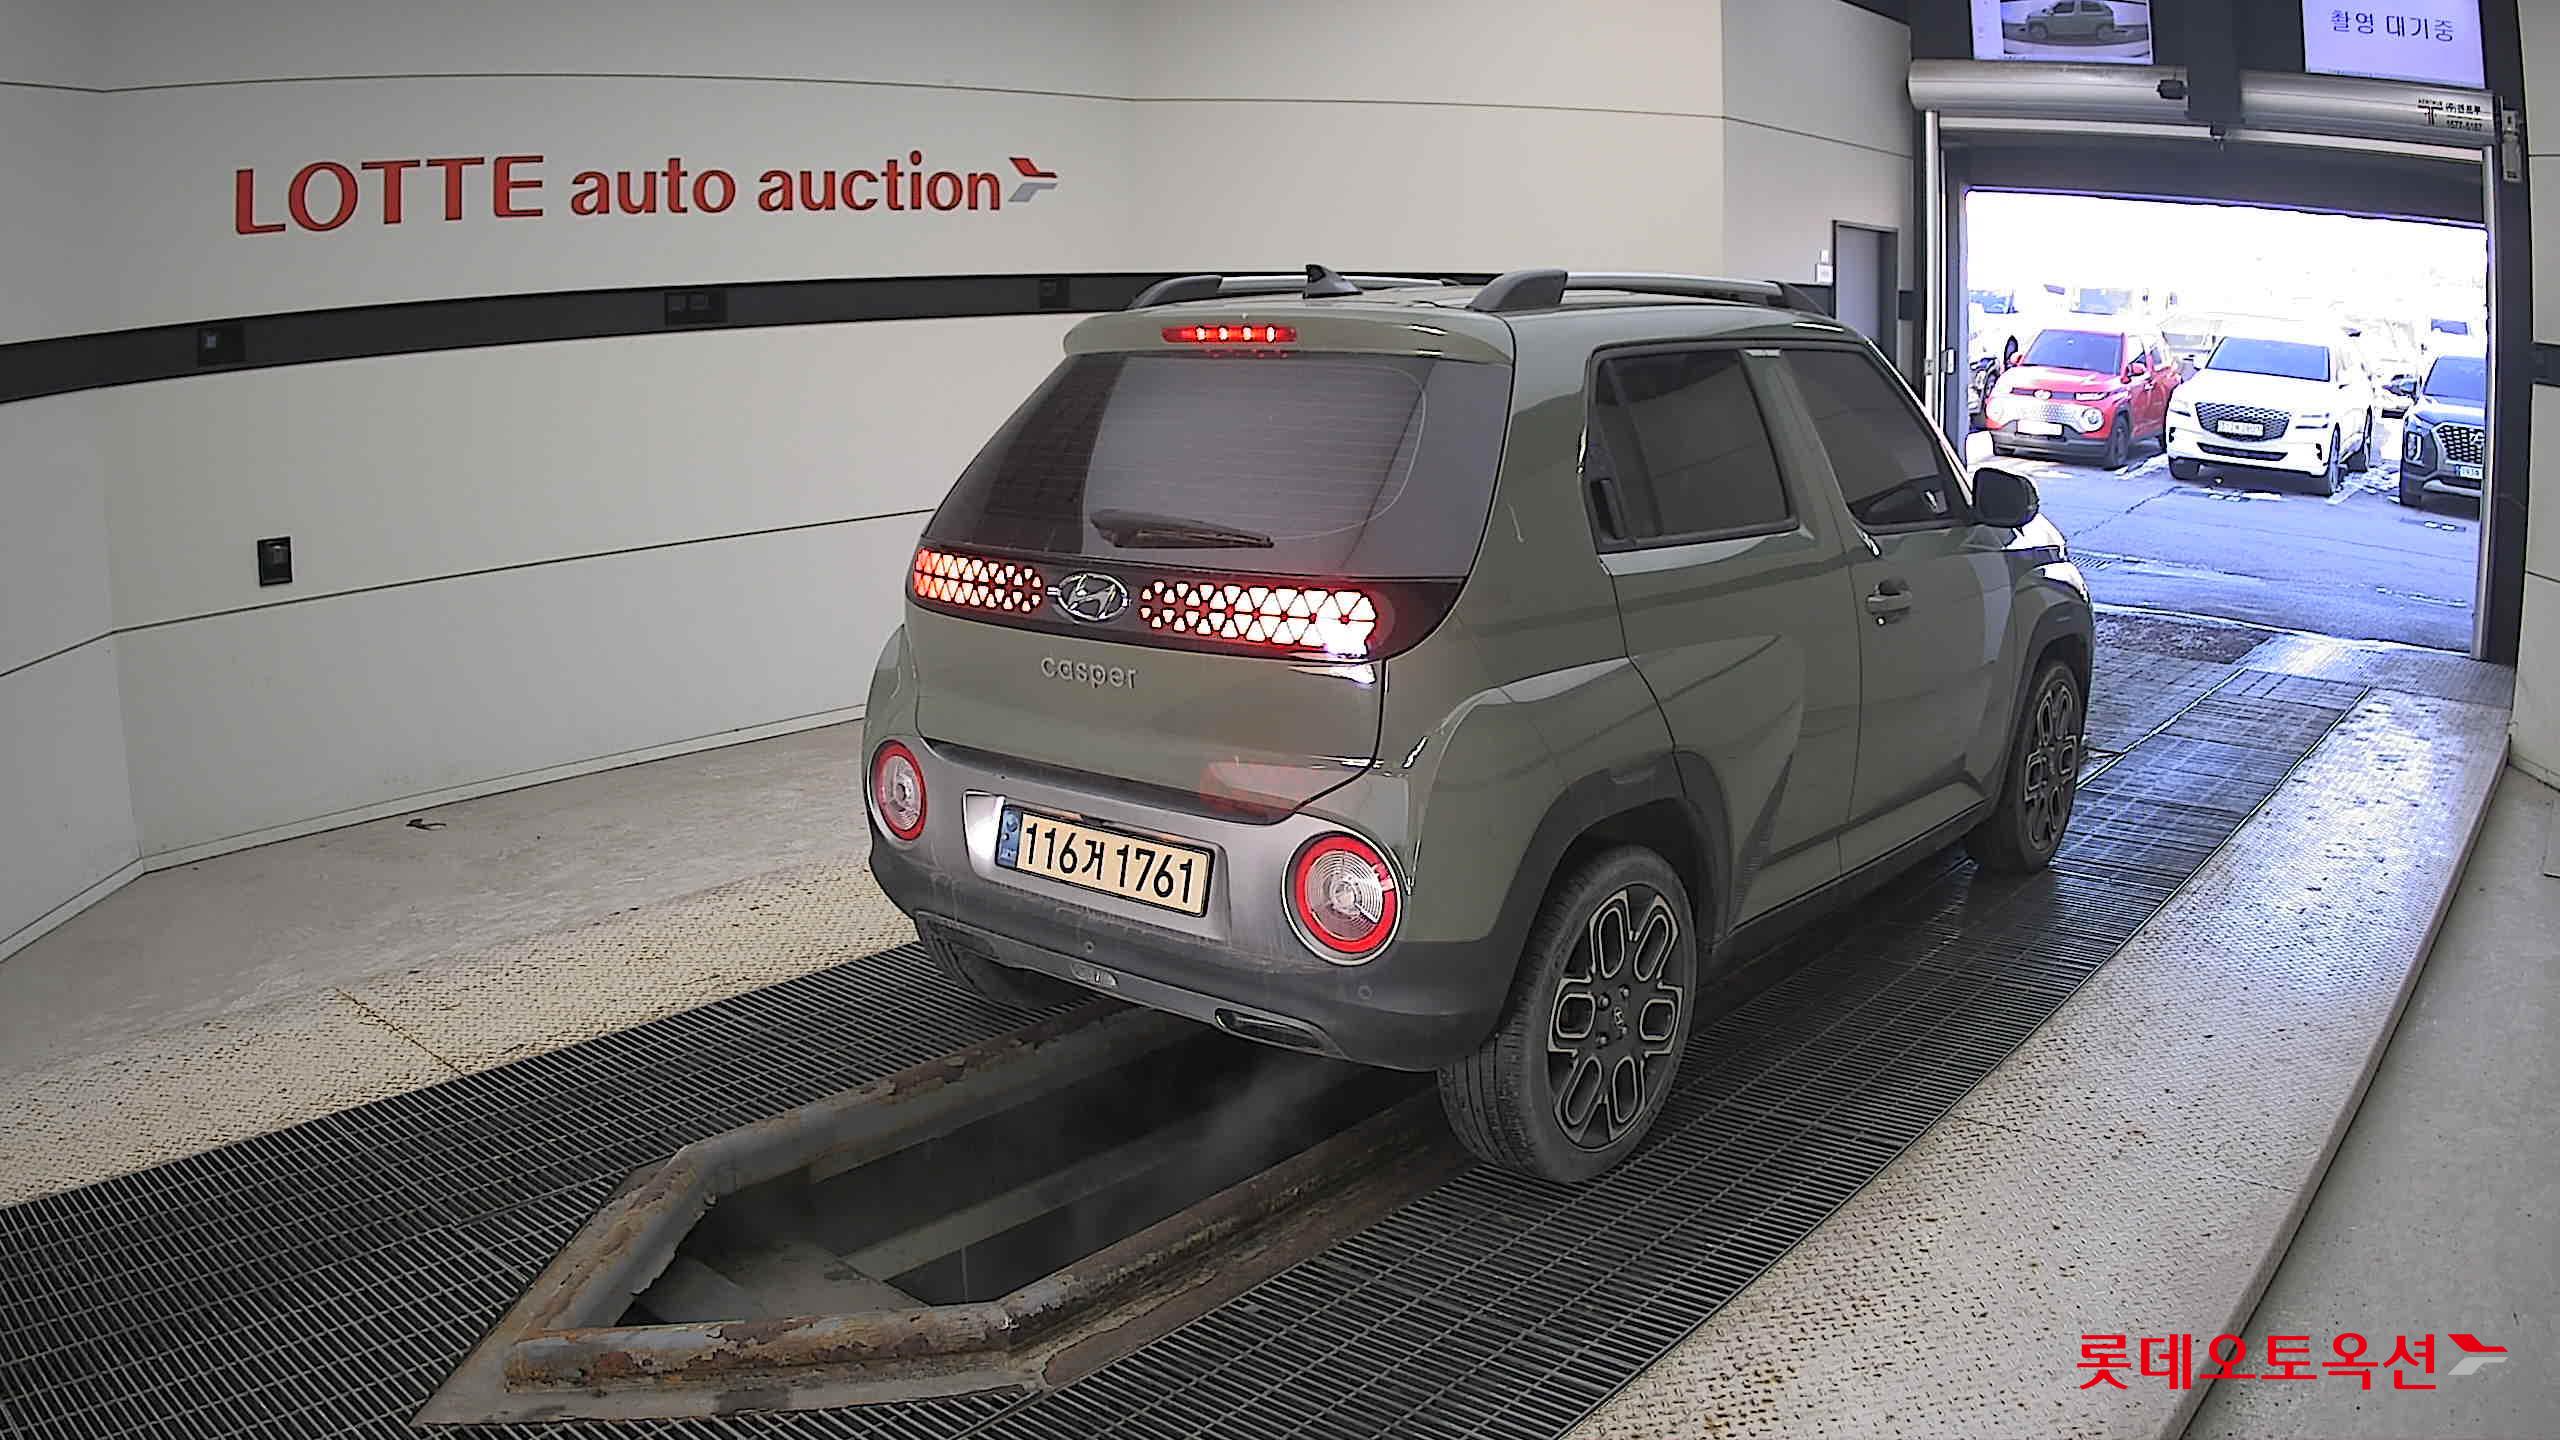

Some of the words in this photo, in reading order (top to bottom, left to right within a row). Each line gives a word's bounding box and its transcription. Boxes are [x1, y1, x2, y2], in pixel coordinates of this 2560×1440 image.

[2329, 8, 2375, 35] 촬영
[2385, 14, 2454, 42] 대기중
[235, 155, 544, 235] LOTTE
[570, 157, 738, 215] auto
[758, 150, 1002, 212] auction
[1040, 656, 1137, 689] casper
